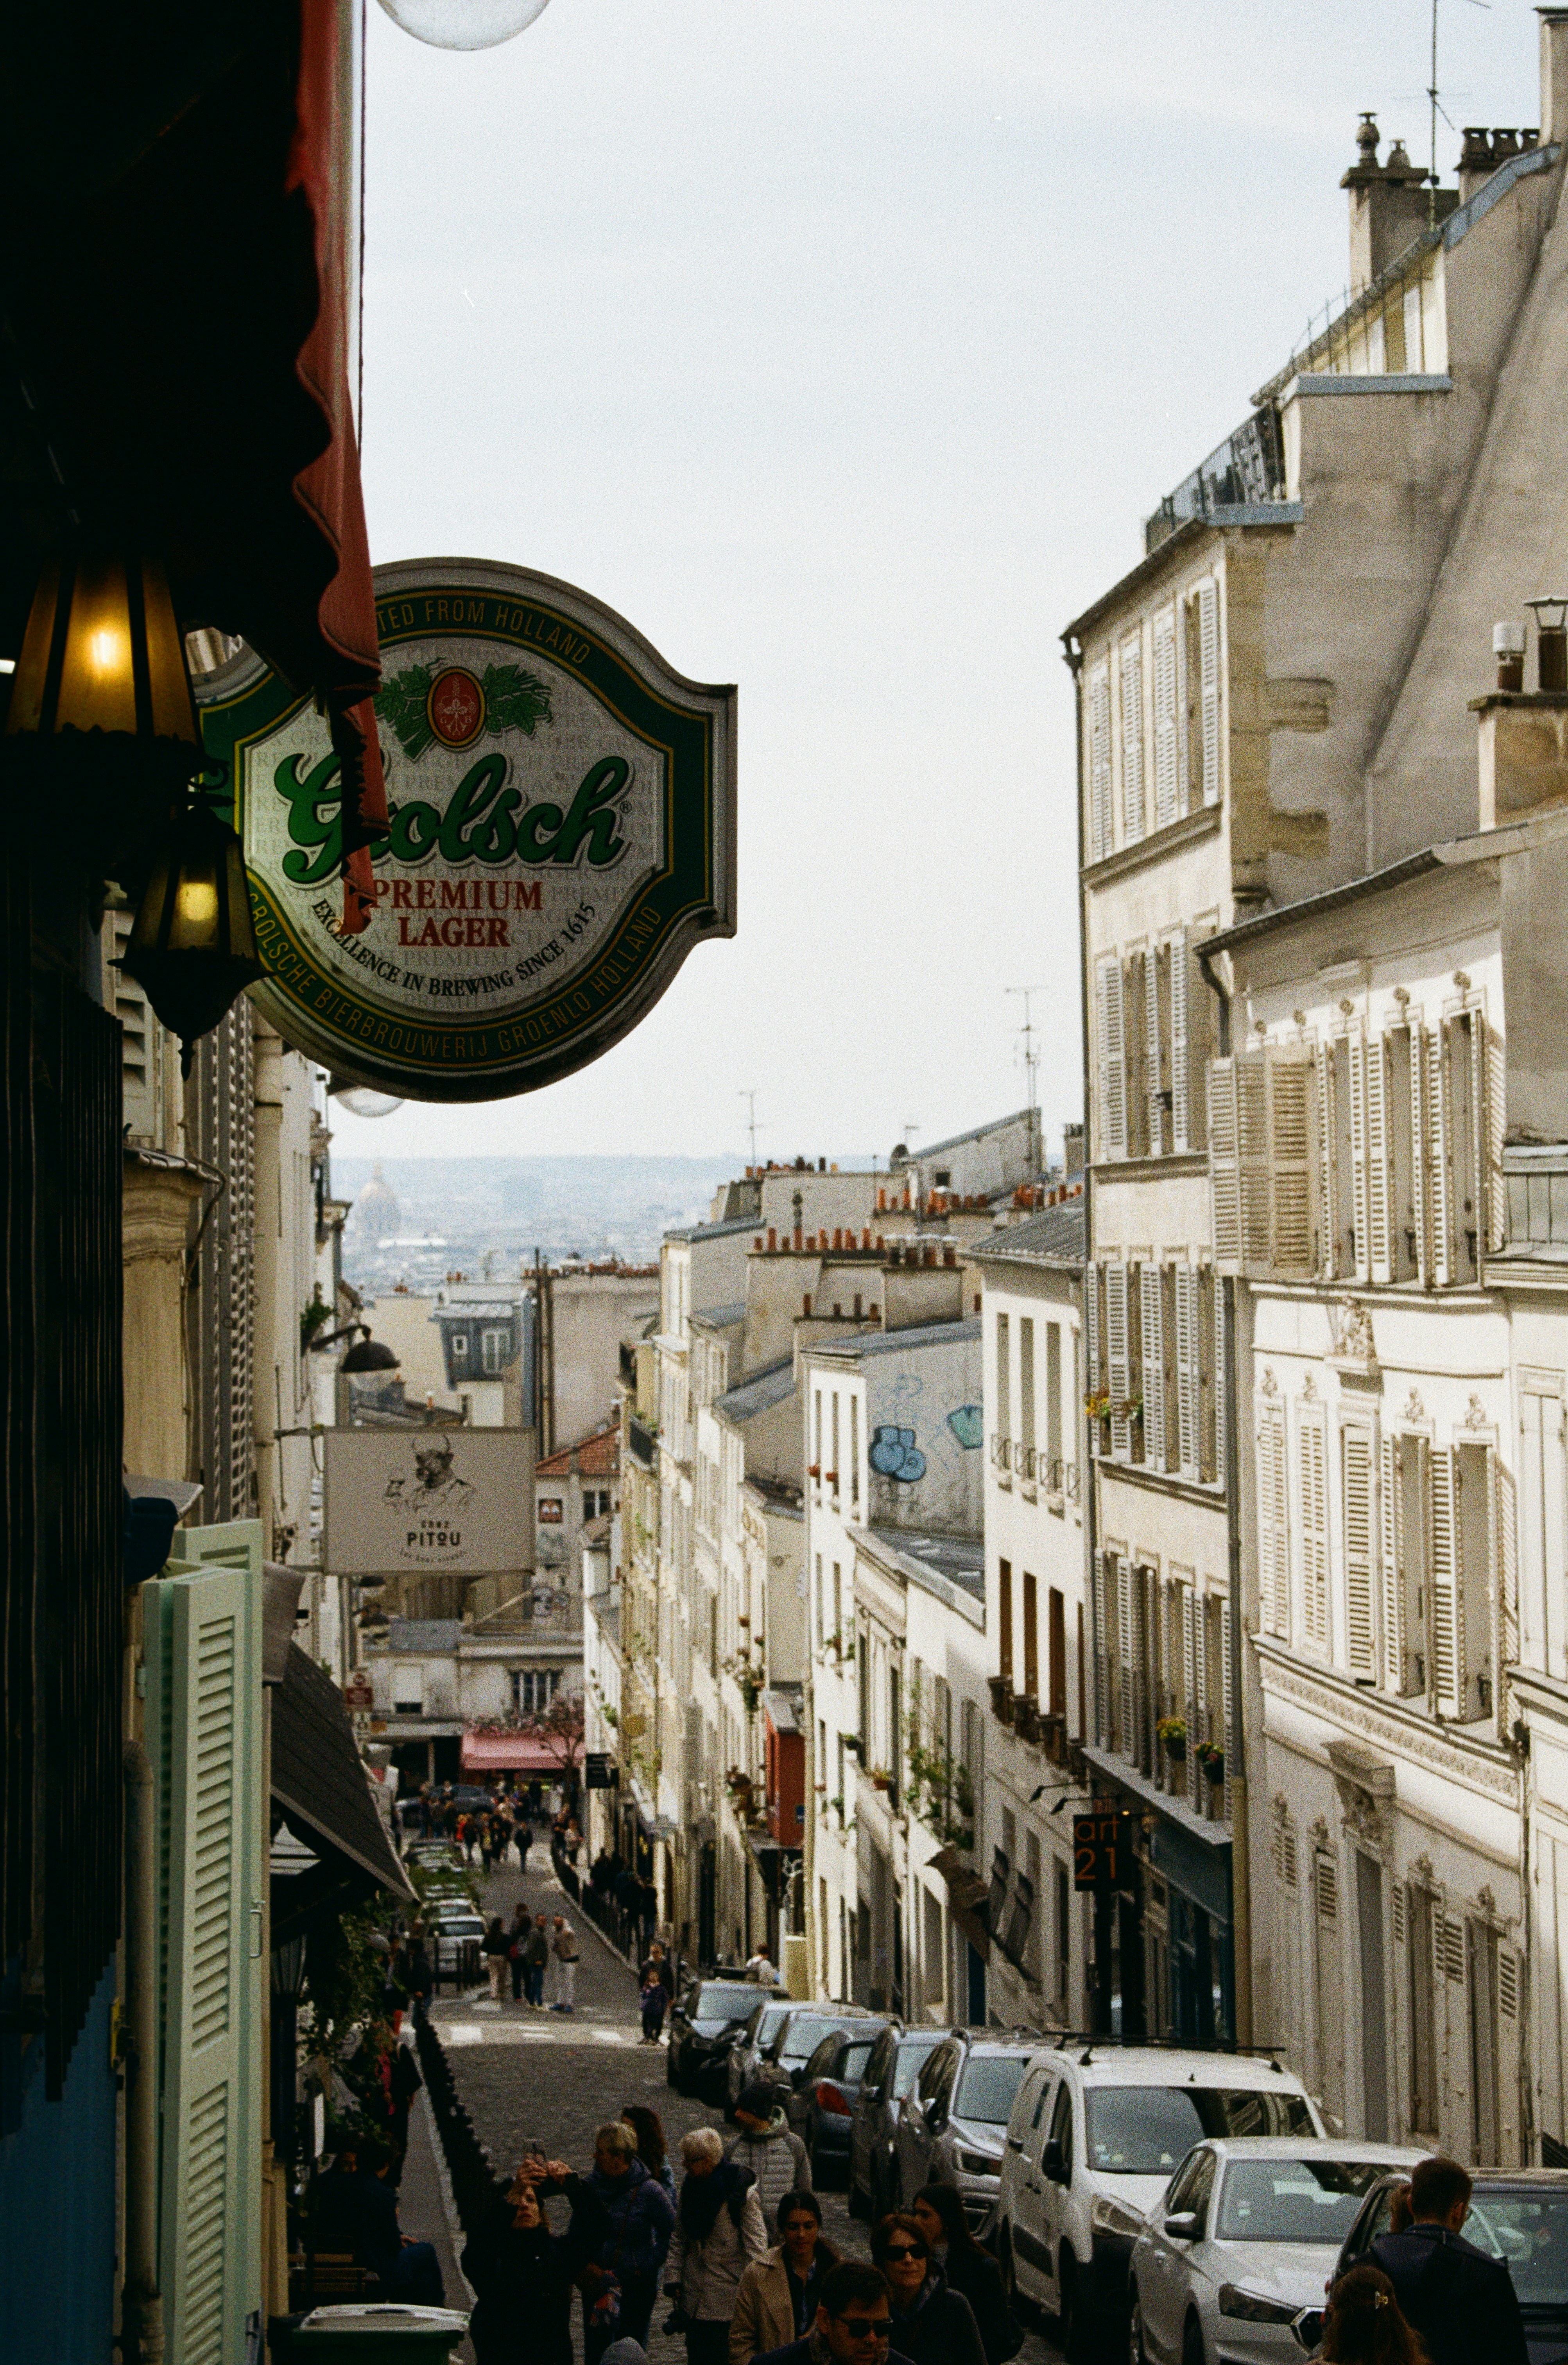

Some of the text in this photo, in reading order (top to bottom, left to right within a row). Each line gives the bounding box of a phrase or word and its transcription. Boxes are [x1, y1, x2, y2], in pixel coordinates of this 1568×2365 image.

[425, 599, 485, 624] FROM
[495, 605, 591, 664] HOLLAND
[273, 752, 627, 885] Golsch
[369, 879, 544, 911] PREMIUM
[311, 898, 595, 996] EXCELLENCE IN BREWING SINCE 1615
[397, 916, 511, 947] LAGER
[313, 988, 487, 1058] BIERBROUWERIJ
[498, 991, 591, 1053] GROENLO
[590, 906, 661, 997] HOLLAND
[407, 1531, 461, 1547] PITOU
[1075, 1814, 1120, 1842] art
[1075, 1847, 1116, 1881] 21
